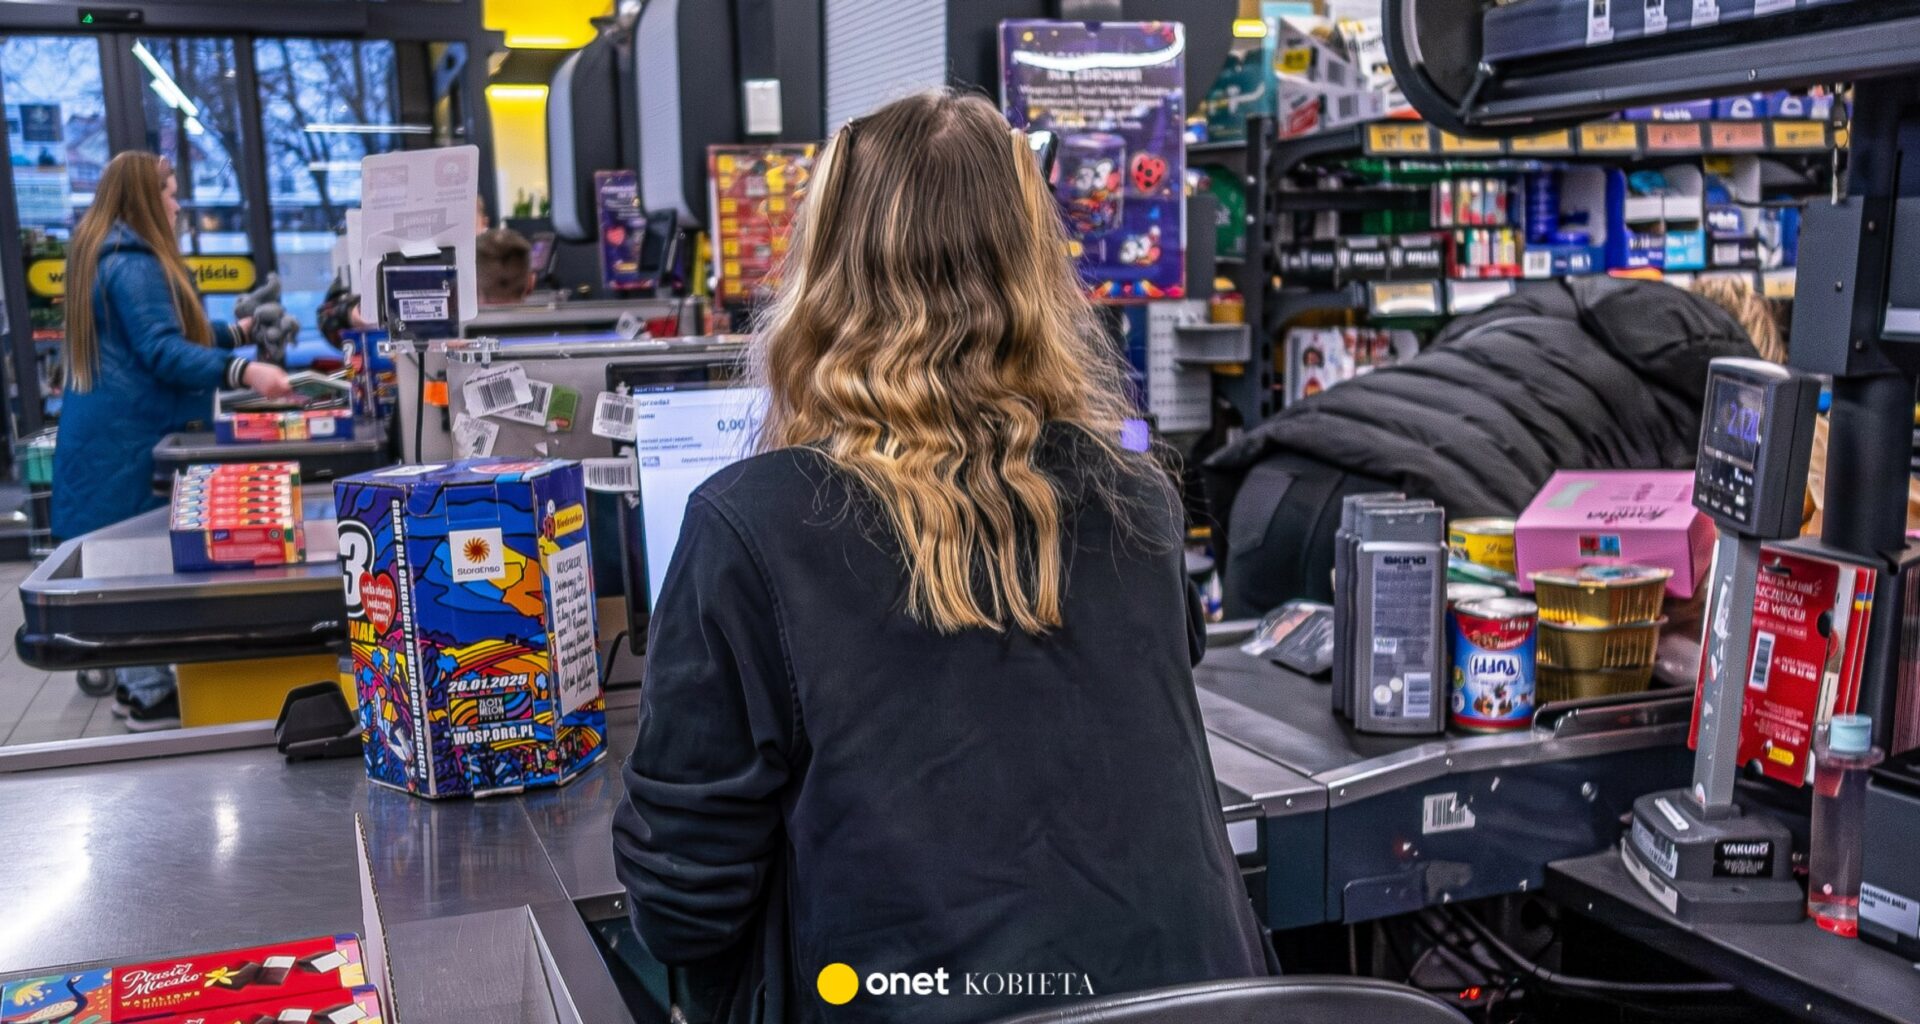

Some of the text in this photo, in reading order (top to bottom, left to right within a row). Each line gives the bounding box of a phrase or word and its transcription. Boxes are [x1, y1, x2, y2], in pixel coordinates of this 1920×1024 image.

[192, 267, 239, 283] yjście
[717, 419, 746, 432] 0,00
[391, 499, 403, 542] GRAMY
[396, 543, 406, 568] DLA
[456, 566, 501, 577] StoraEnso
[398, 568, 413, 633] ONKOLOGII
[405, 640, 420, 717] HEMATOLOGII
[447, 673, 528, 694] 26.01.2025
[453, 723, 535, 746] WOSP.ORG.PL
